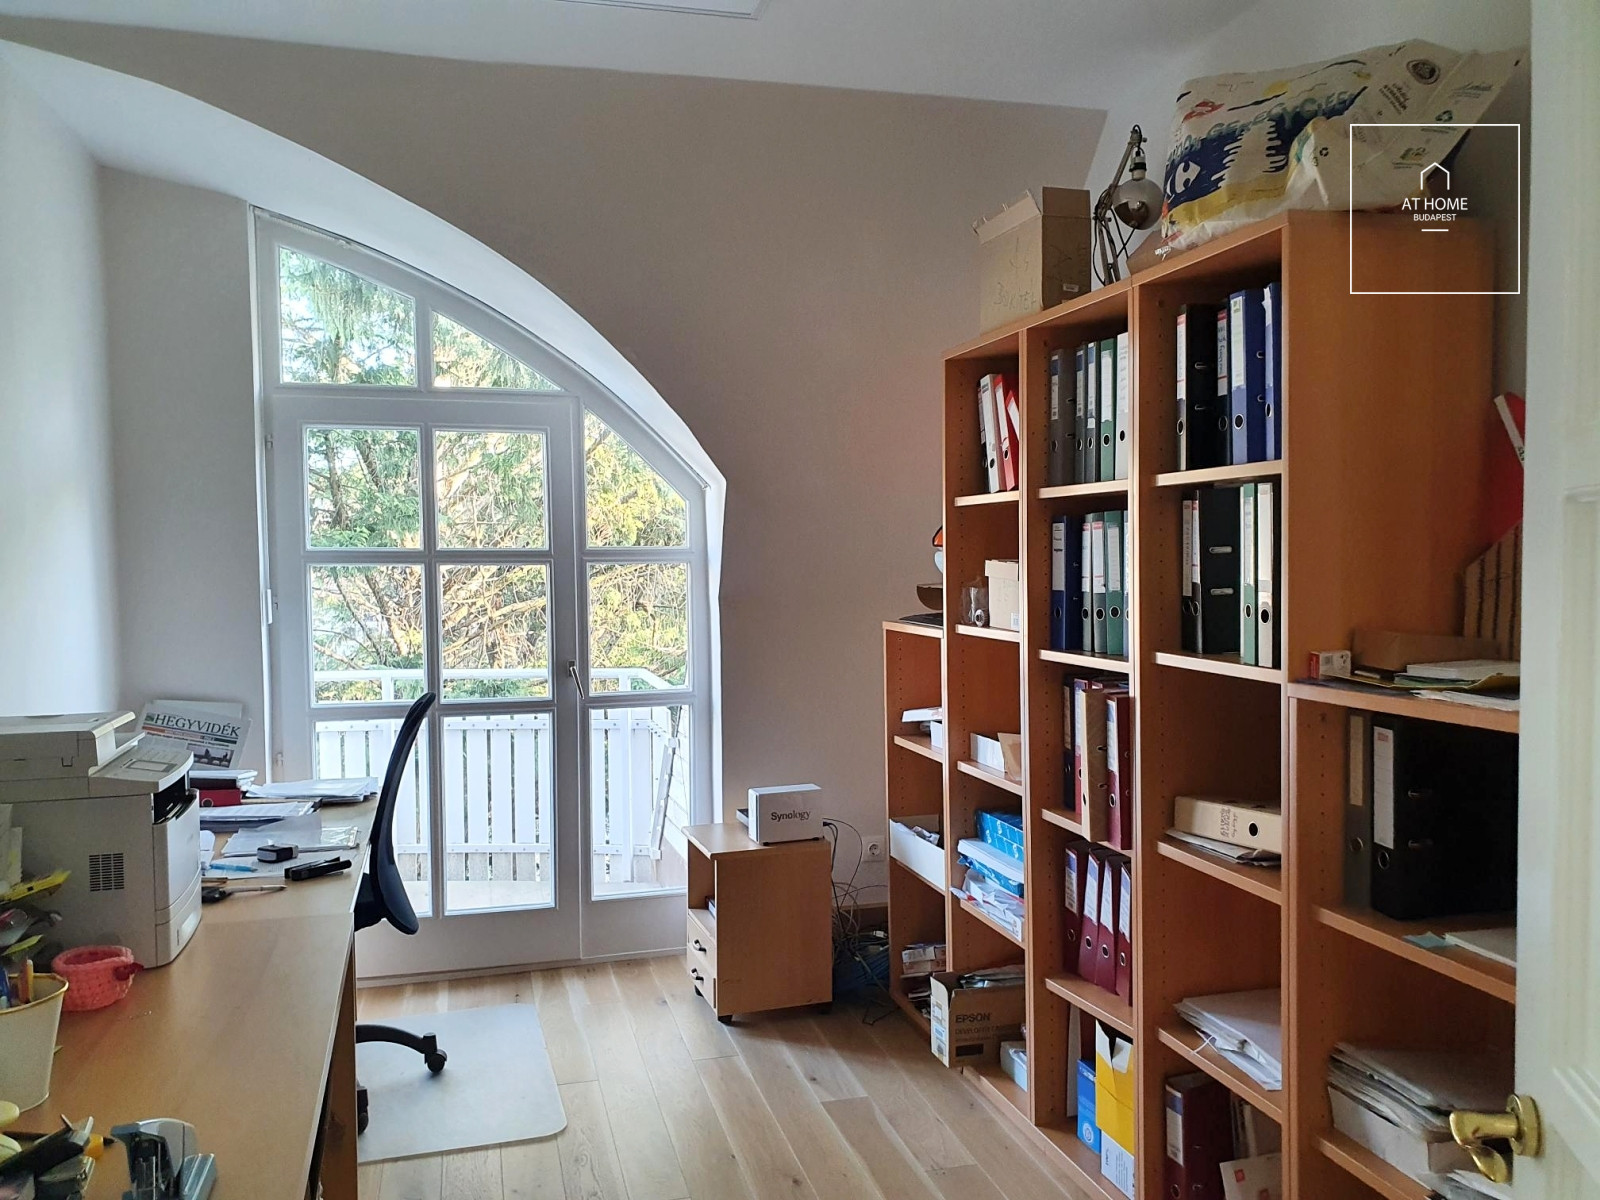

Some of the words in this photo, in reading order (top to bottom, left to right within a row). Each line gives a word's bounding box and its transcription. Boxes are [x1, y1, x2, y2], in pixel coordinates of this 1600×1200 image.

[154, 713, 241, 737] HEGYVIDÉK
[770, 810, 811, 822] Synology
[955, 1012, 991, 1023] EPSON
